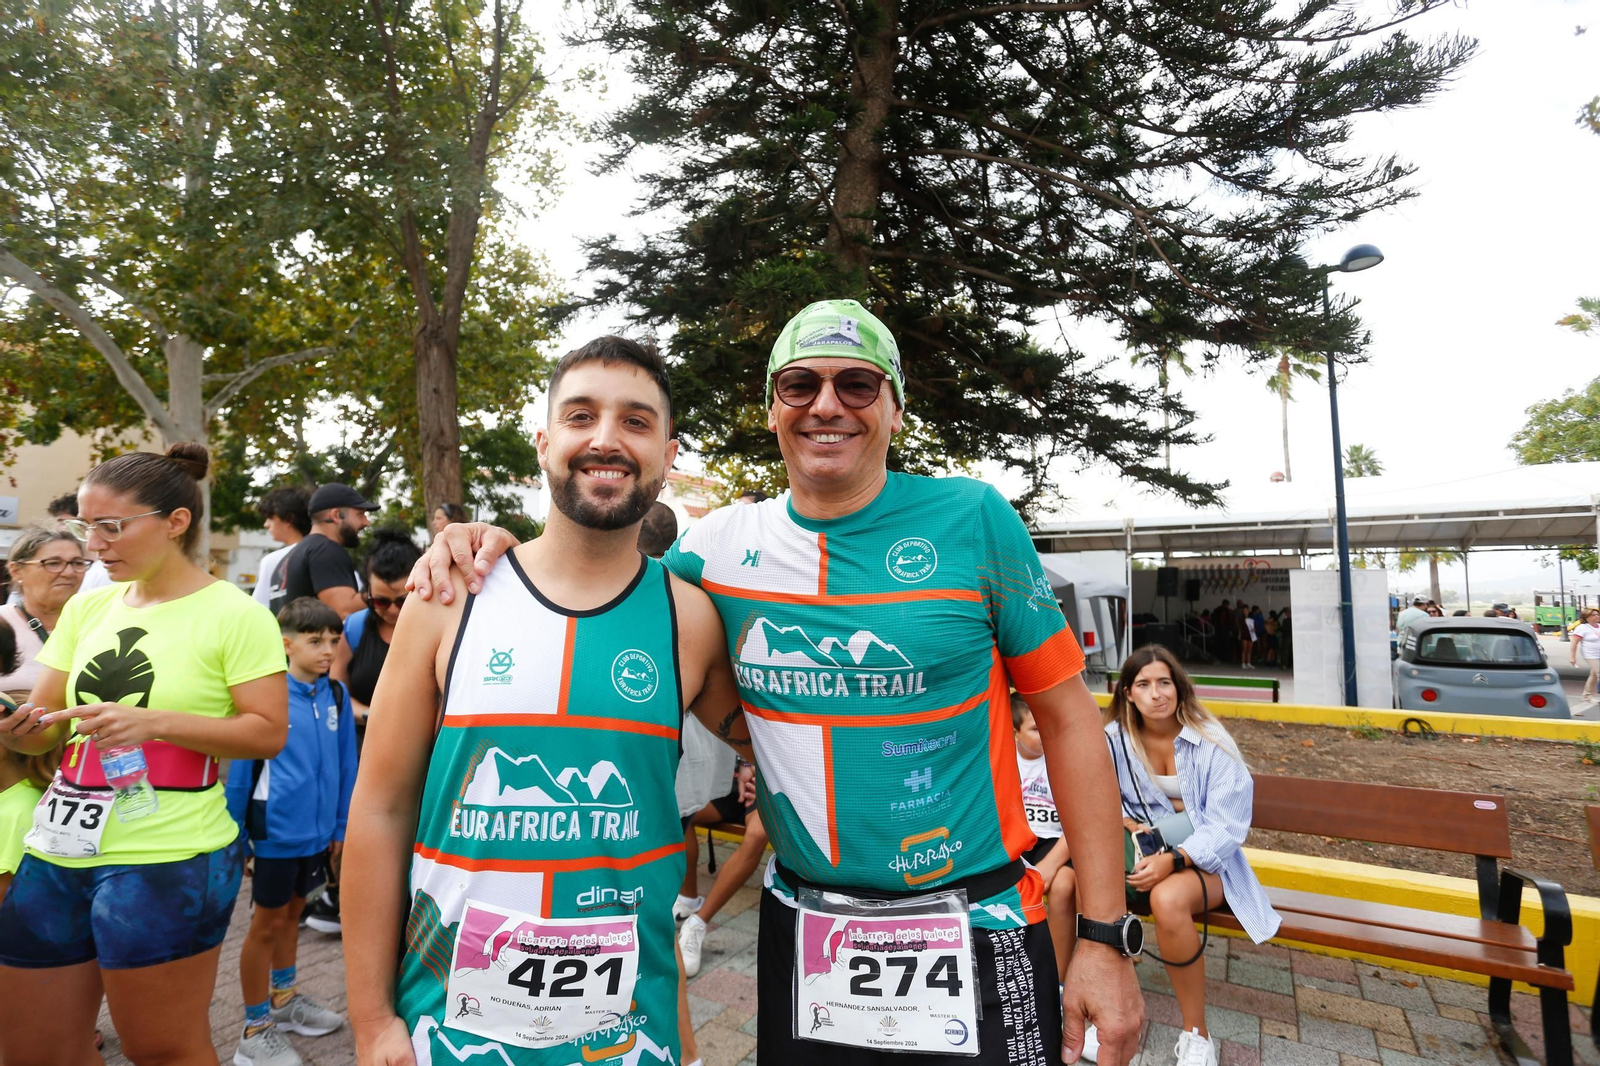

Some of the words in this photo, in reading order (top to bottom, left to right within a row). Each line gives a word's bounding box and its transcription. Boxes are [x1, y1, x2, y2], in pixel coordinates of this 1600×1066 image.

[892, 544, 904, 557] CLUB
[903, 541, 931, 554] DEPORTIVO
[892, 564, 920, 579] EURAFRICA
[618, 654, 630, 667] CLUB
[630, 653, 654, 673] DEPORTIVO
[617, 677, 642, 697] EURAFRICA
[734, 663, 850, 698] EURAFRICA
[854, 672, 927, 697] TRAIL
[890, 789, 951, 811] FARMACIA
[48, 797, 104, 830] 173
[450, 807, 581, 842] EURAFRICA
[589, 809, 641, 840] TRAIL
[888, 840, 963, 873] CHURRASCO
[576, 886, 644, 906] dinan
[988, 932, 1003, 955] TRAIL
[508, 957, 624, 998] 421
[849, 955, 963, 997] 274
[994, 956, 1010, 1002] EURAFRICA
[1006, 978, 1021, 1004] TRAIL
[1002, 1002, 1014, 1028] TRAIL
[1023, 998, 1032, 1025] TRAIL
[1026, 972, 1038, 1025] EURAFRICA
[1033, 1025, 1043, 1054] TRAIL
[522, 1034, 555, 1042] Septiembre
[873, 1039, 904, 1047] Septiembre
[1013, 1005, 1027, 1060] EURAFRICA
[1006, 1036, 1018, 1063] TRAIL
